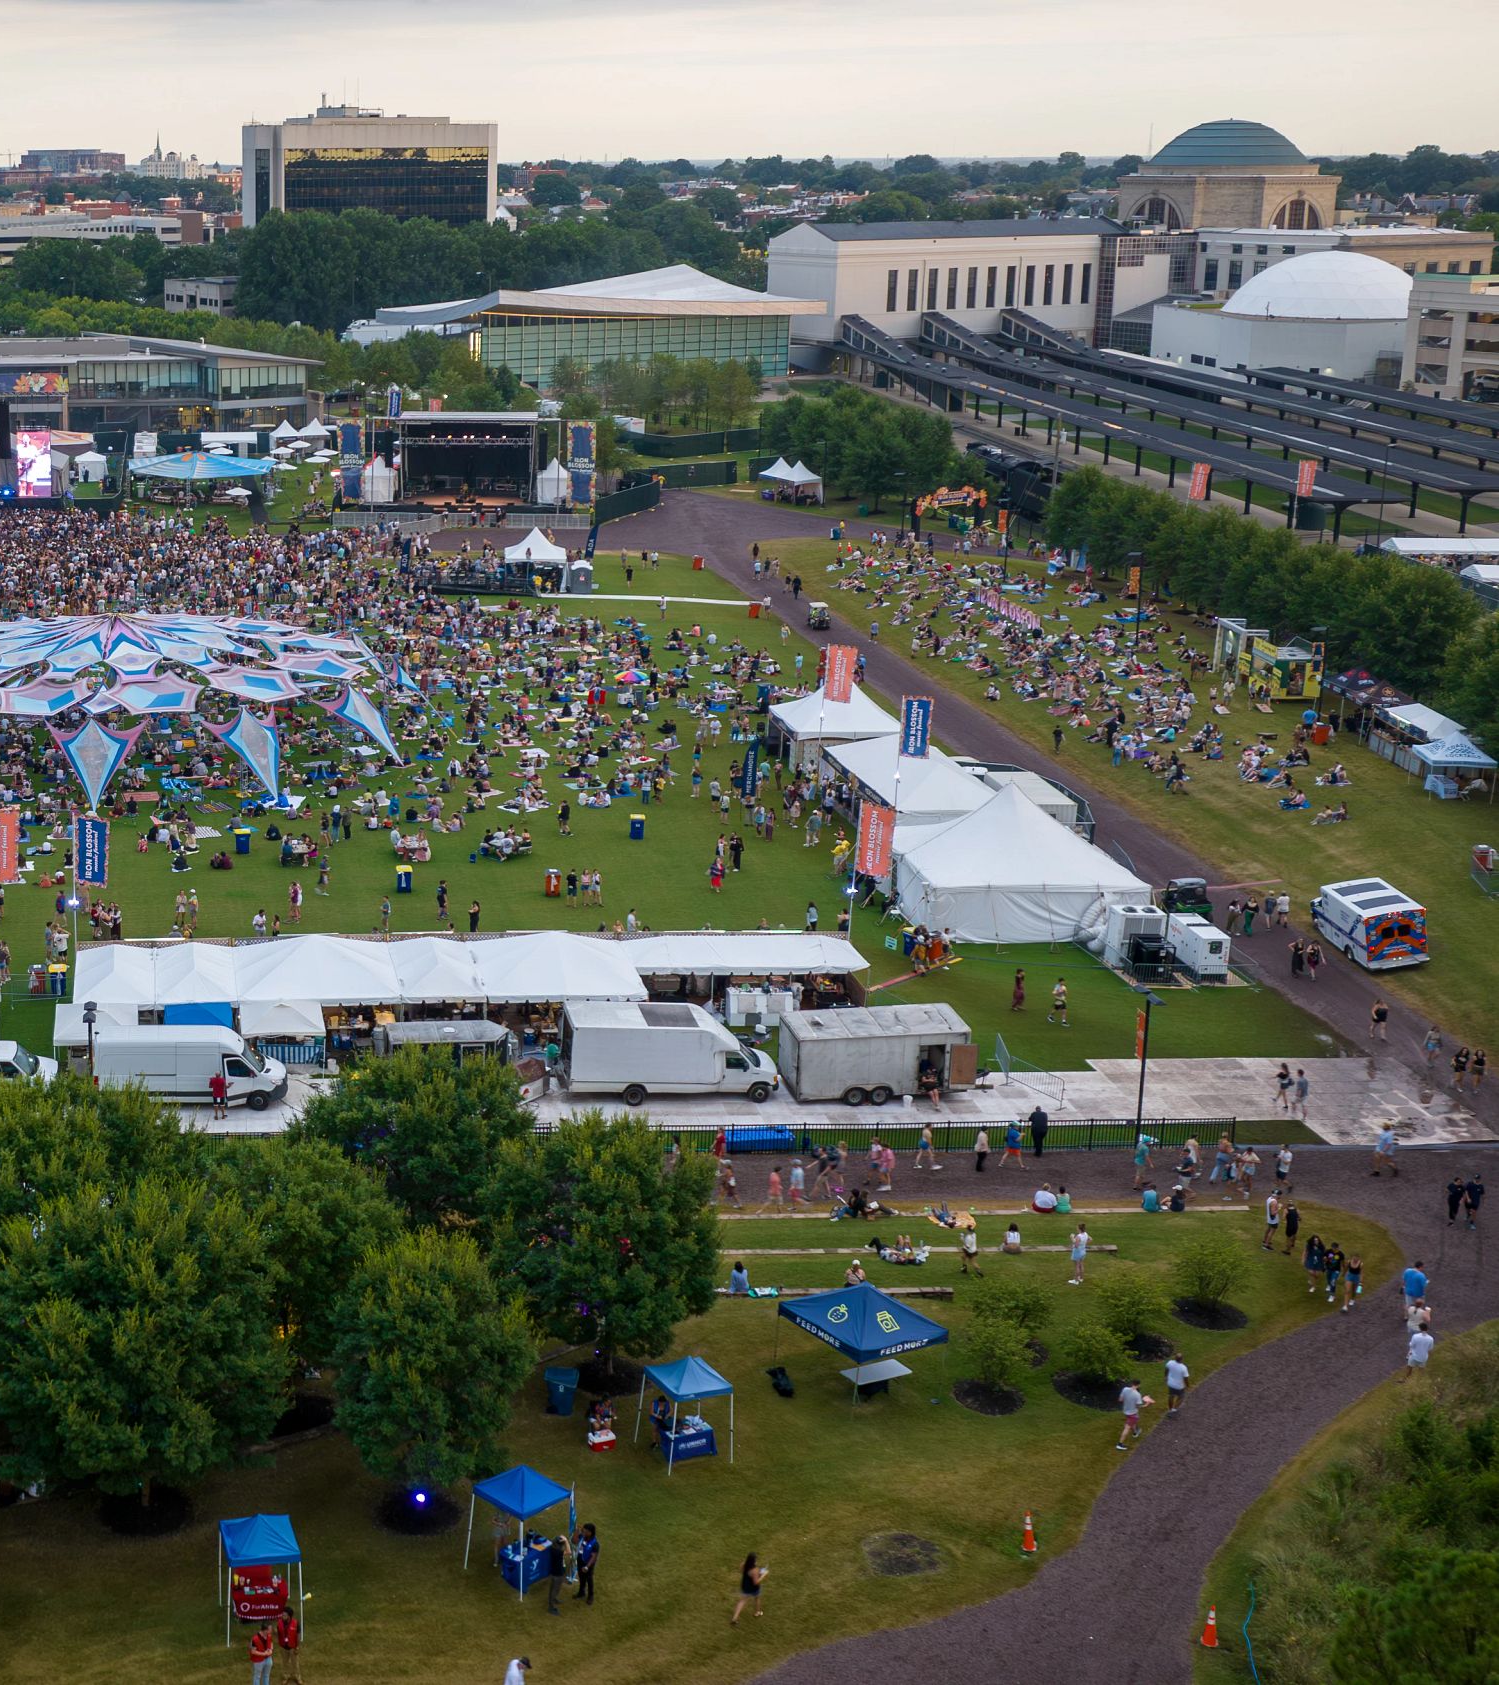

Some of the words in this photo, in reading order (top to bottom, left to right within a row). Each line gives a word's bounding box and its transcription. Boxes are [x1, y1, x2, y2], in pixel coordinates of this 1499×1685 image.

[834, 650, 843, 680] BLOSSOM
[832, 680, 840, 697] IRON
[910, 701, 919, 735] BLOSSOM
[916, 708, 924, 730] festival
[907, 735, 916, 754] IRON
[745, 750, 755, 794] MERCHANDISE
[868, 810, 879, 849] BLOSSOM
[85, 860, 93, 879] IRON
[866, 849, 874, 870] IRON
[796, 1316, 817, 1334] FEED
[817, 1328, 841, 1348] MORE
[880, 1344, 904, 1356] FEED
